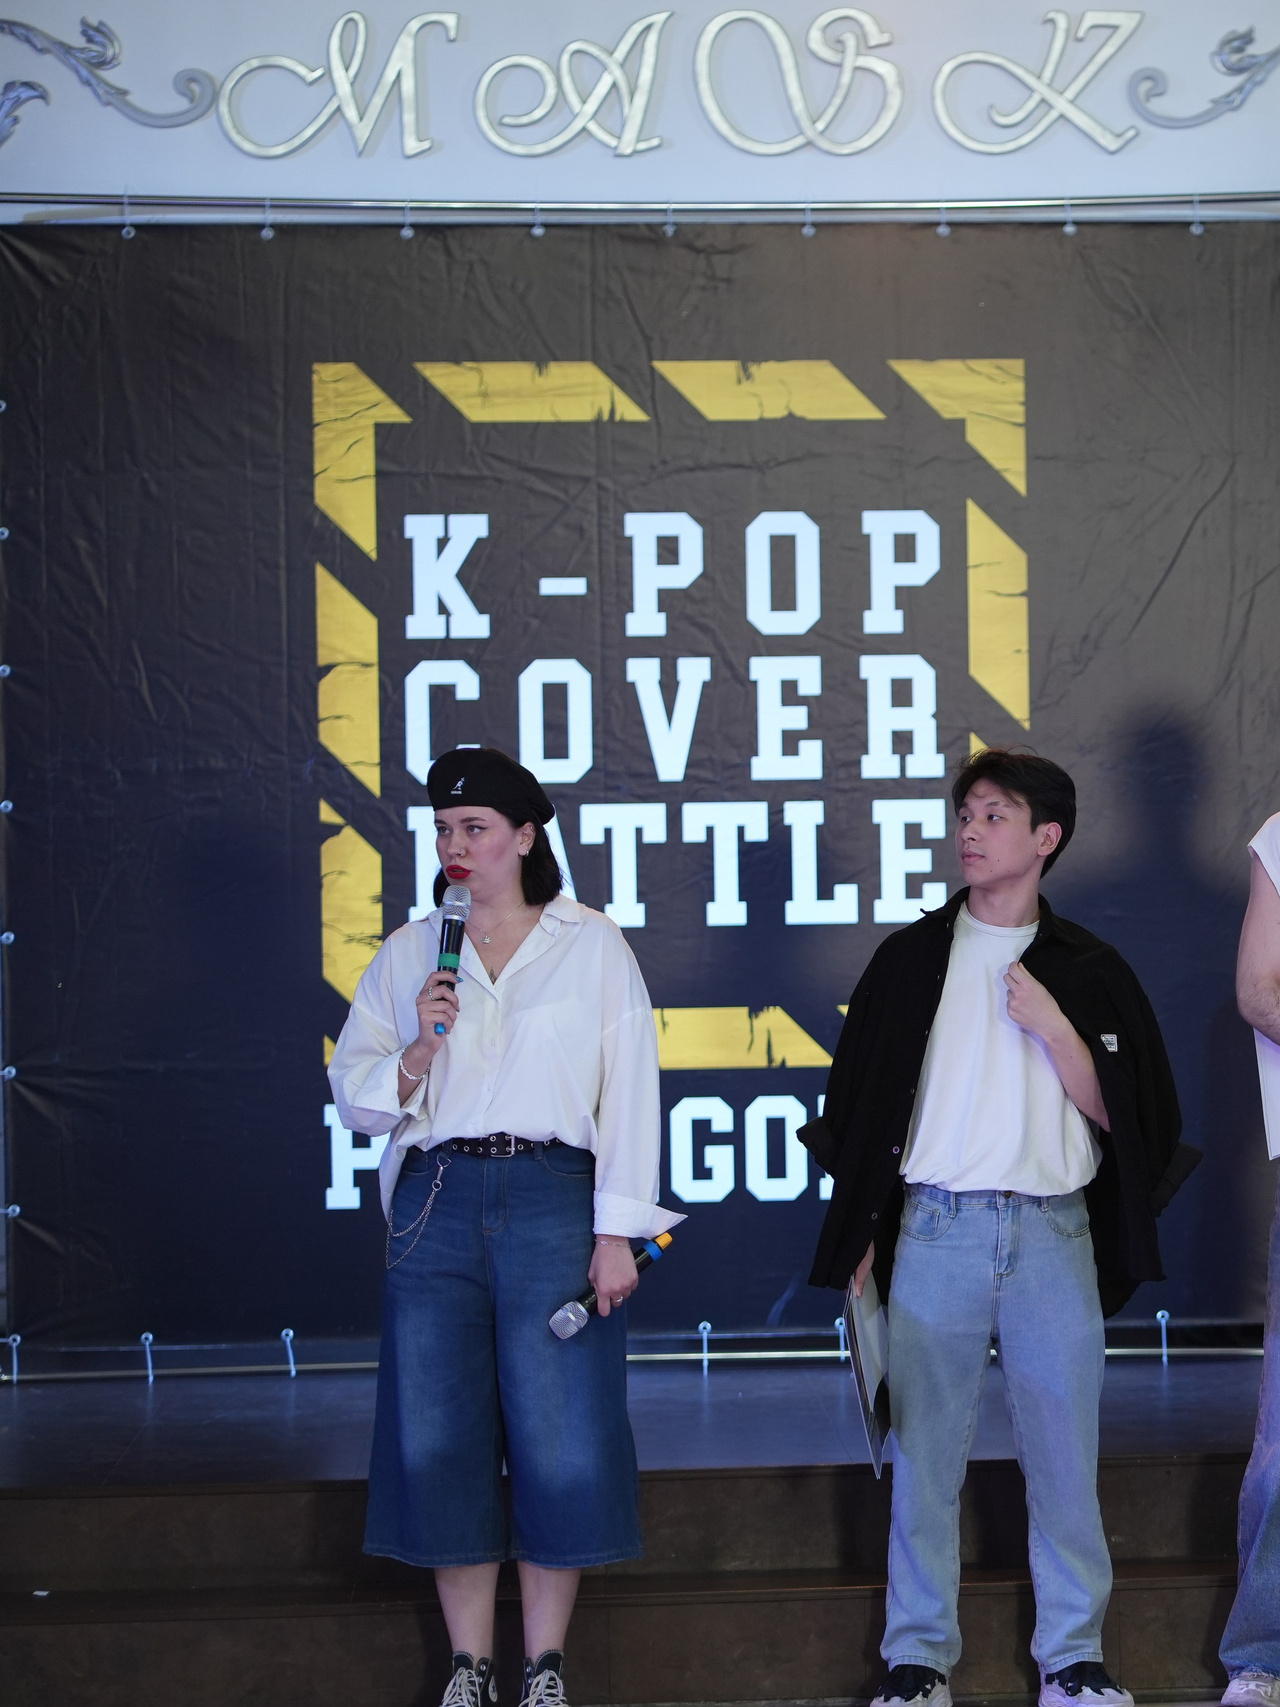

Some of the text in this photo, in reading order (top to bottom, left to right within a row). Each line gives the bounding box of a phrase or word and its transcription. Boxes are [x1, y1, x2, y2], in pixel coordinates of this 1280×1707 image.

[403, 509, 941, 640] K-POP
[404, 653, 946, 785] COVER
[406, 799, 947, 928] TTLE
